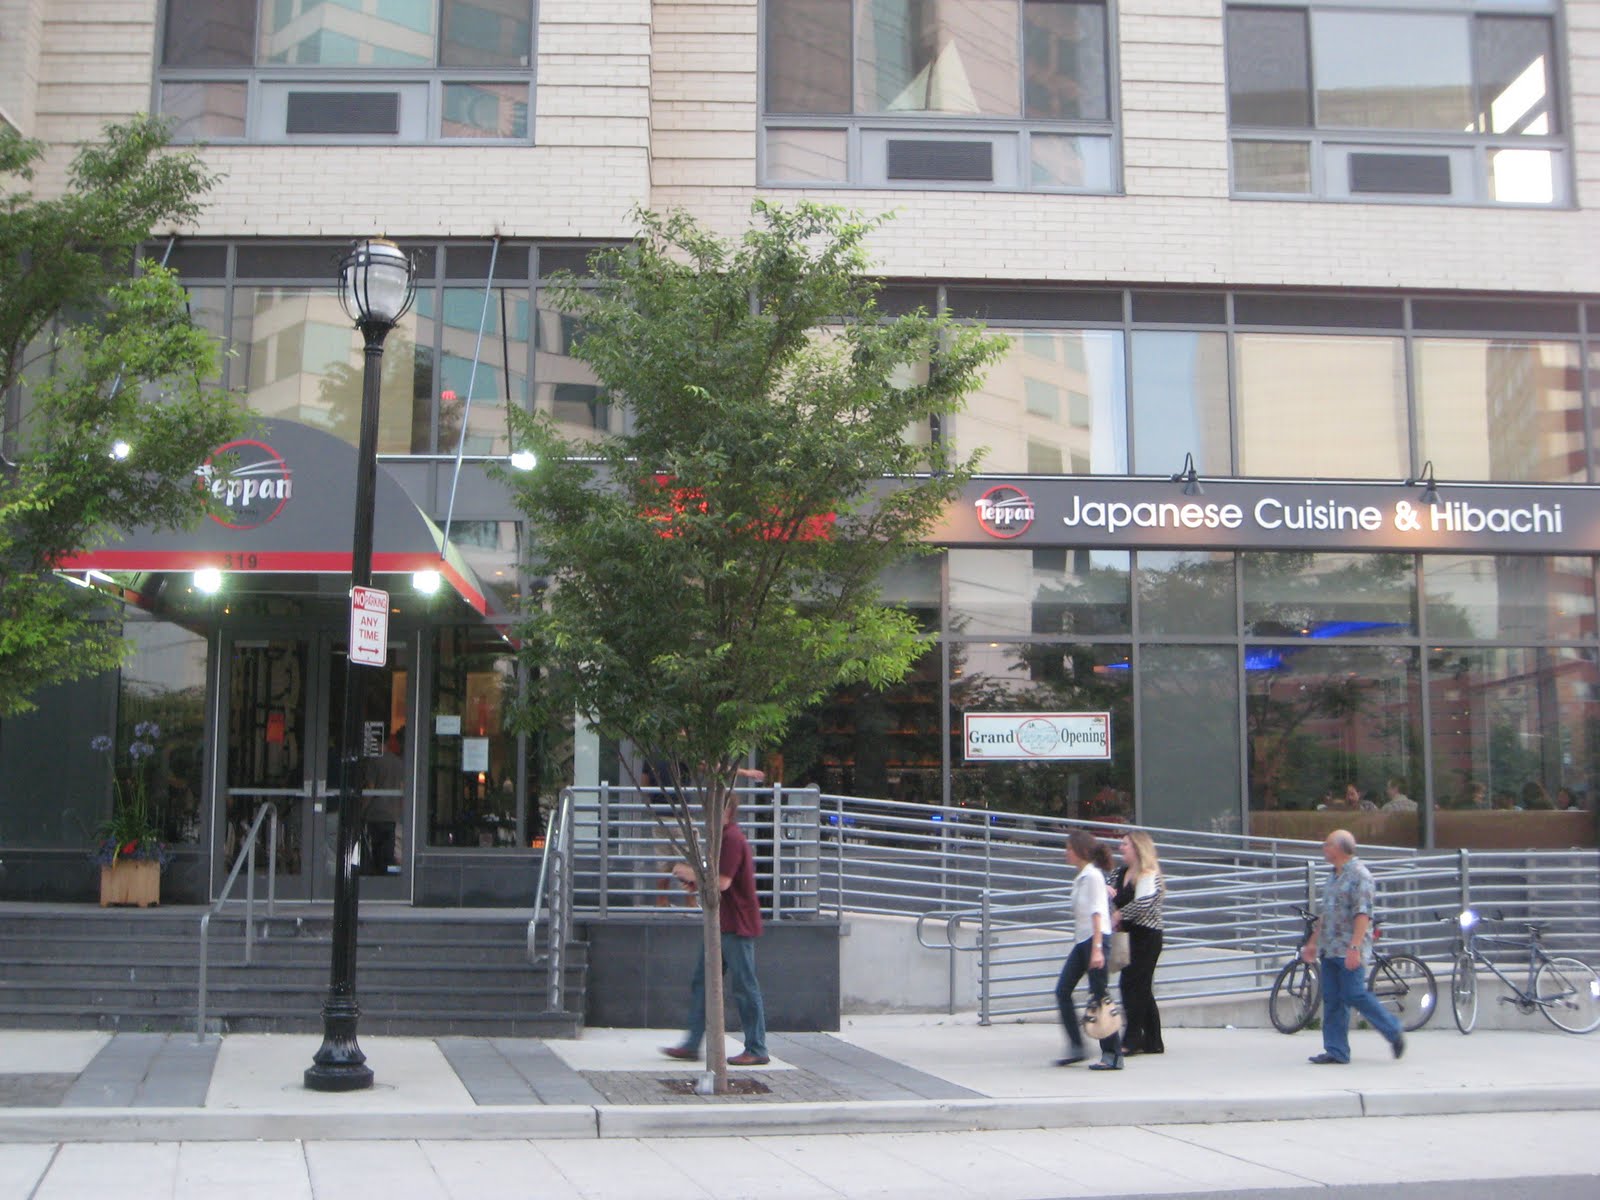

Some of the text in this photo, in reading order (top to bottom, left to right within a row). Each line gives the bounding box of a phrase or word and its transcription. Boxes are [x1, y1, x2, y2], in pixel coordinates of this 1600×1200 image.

[975, 499, 1035, 524] Teppan
[1063, 495, 1562, 533] Japanese Cuisine & Hibachi
[224, 554, 258, 569] 319
[354, 592, 386, 609] NO PARKING
[361, 616, 379, 627] ANY
[359, 629, 379, 641] TIME
[969, 730, 1014, 744] Grand
[1061, 728, 1106, 747] Opening
